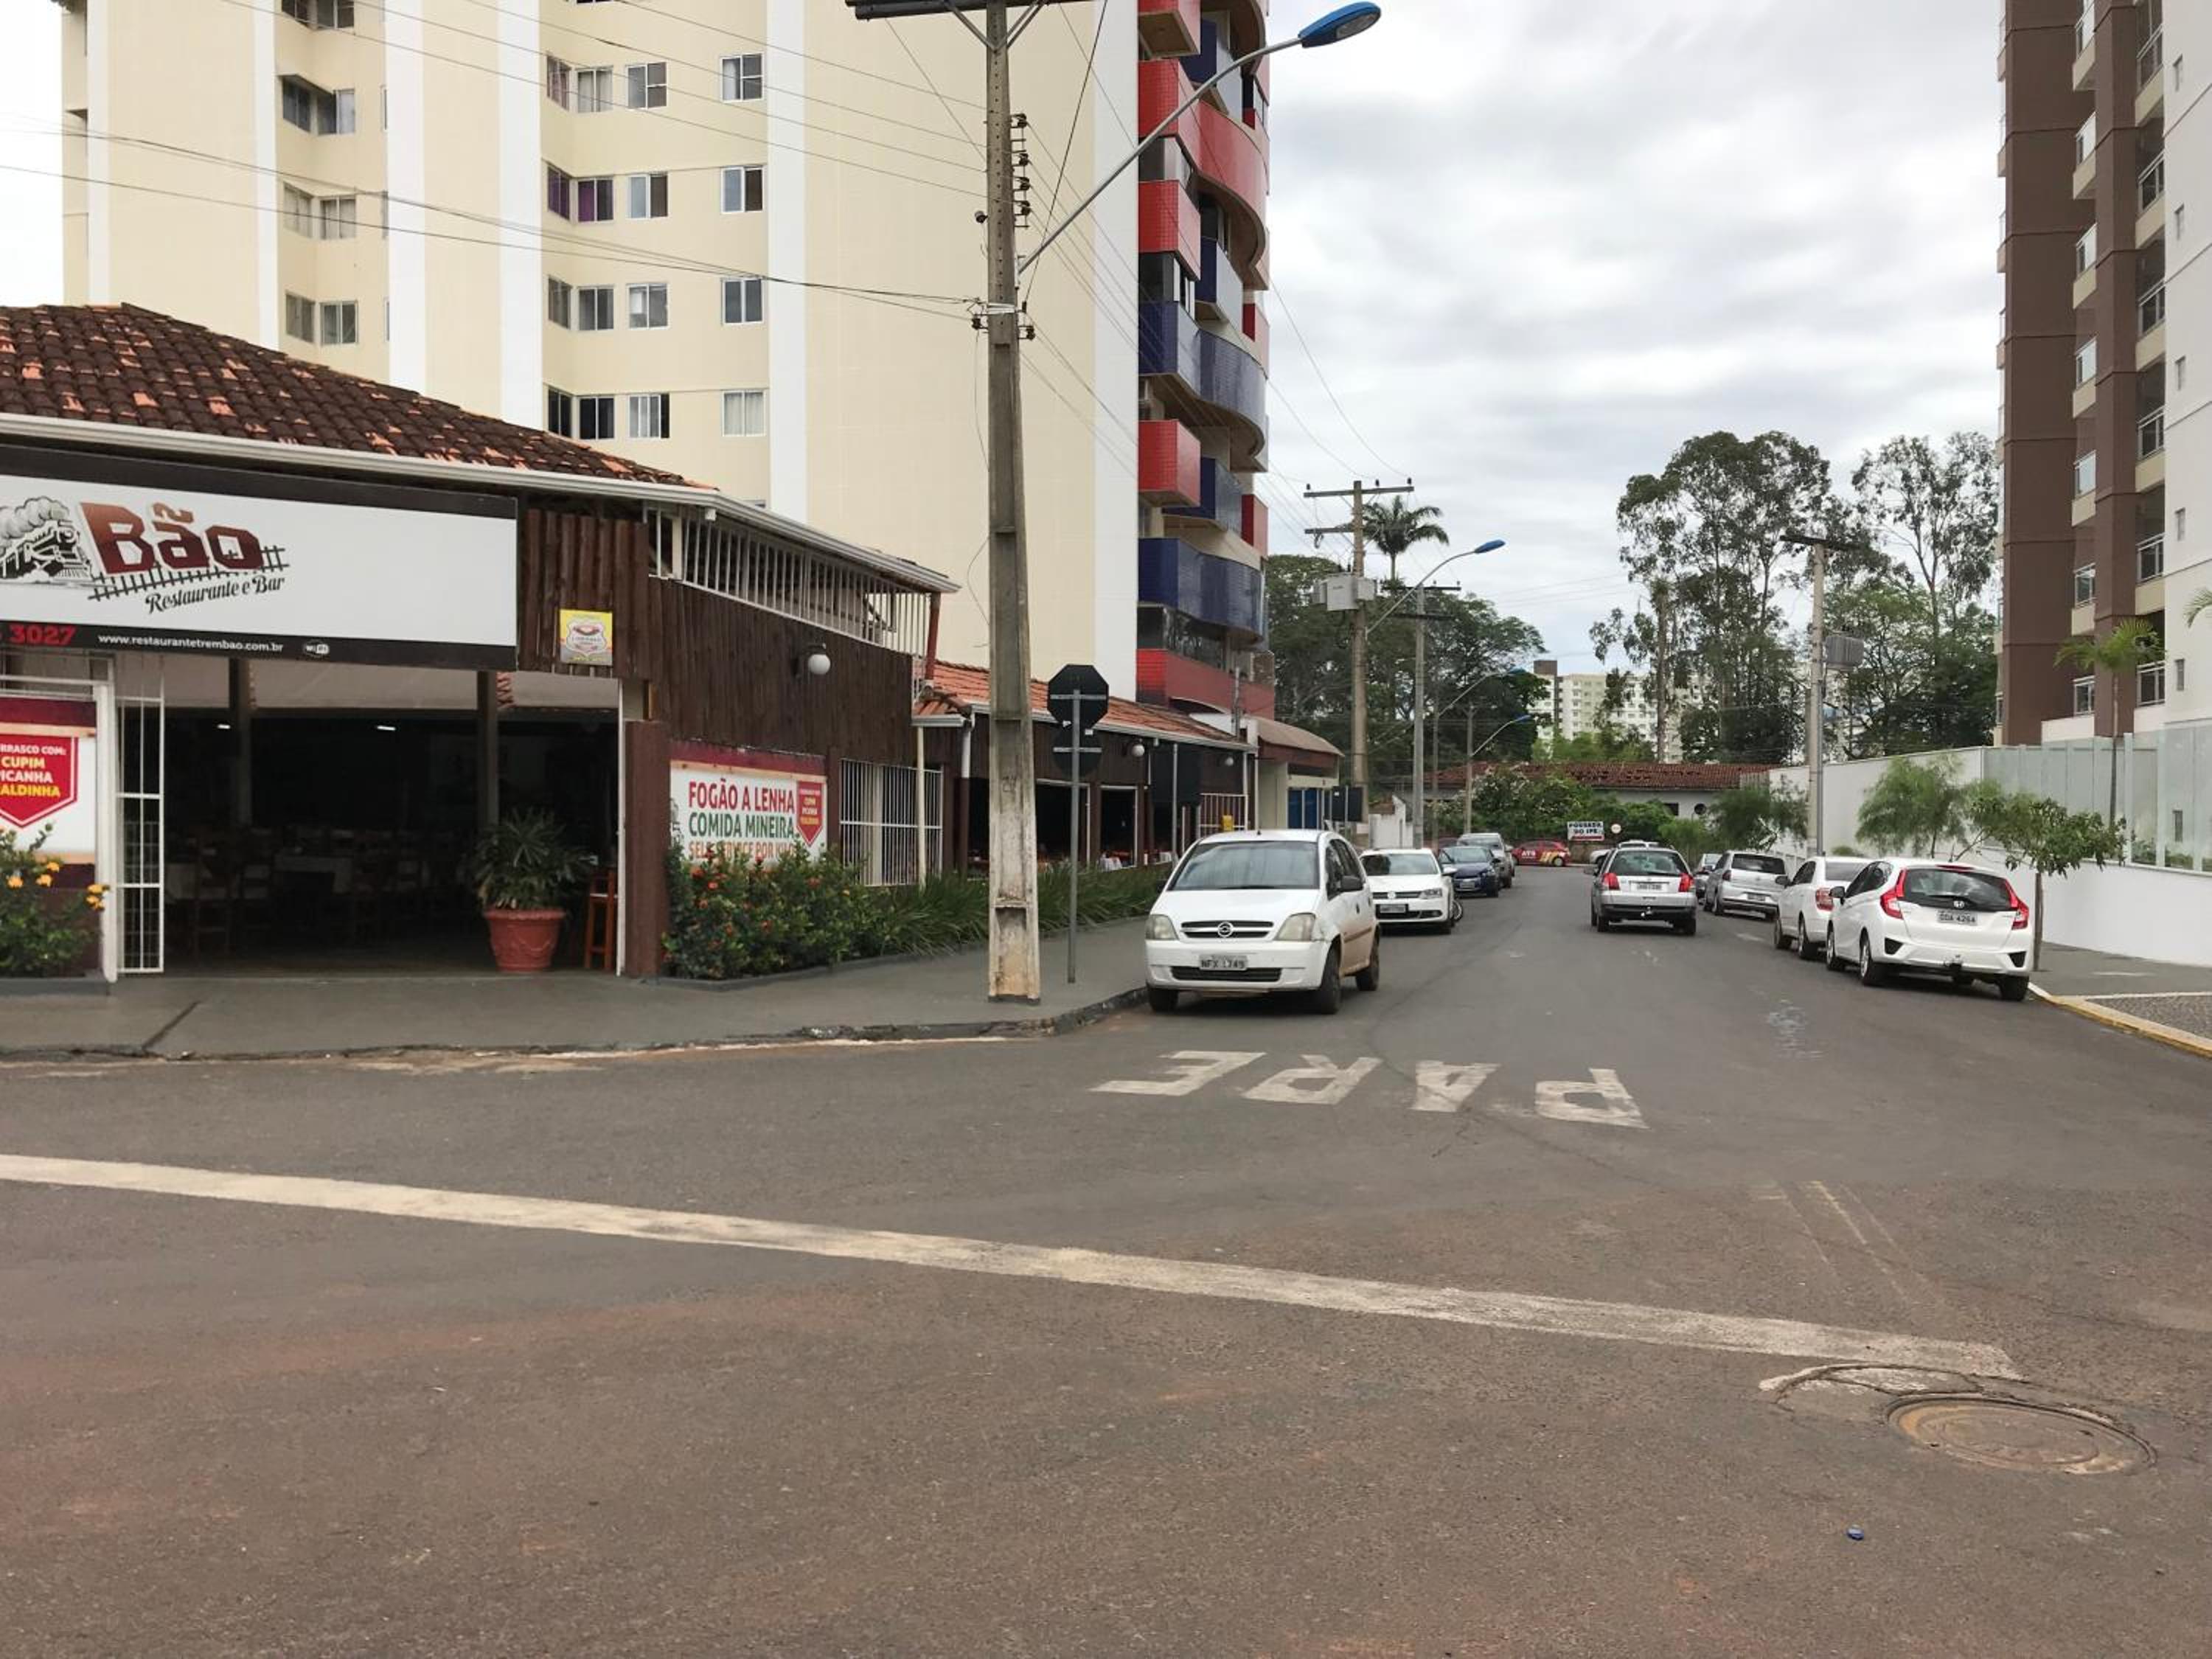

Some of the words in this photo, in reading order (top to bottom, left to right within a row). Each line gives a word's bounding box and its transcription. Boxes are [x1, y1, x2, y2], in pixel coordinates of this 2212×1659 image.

[80, 502, 264, 574] Bão
[145, 580, 240, 613] Restaurante
[242, 583, 248, 594] e
[251, 574, 285, 594] Bar
[10, 625, 77, 645] 3027
[98, 633, 284, 652] www.restaurantetrembao.com.br
[1, 756, 46, 768] CUPIM
[0, 770, 53, 783] ICANHA
[0, 784, 60, 798] ALDINHA
[689, 778, 738, 810] FOGÃO
[742, 785, 751, 810] A
[754, 787, 795, 813] LENHA
[689, 812, 742, 838] COMIDA
[745, 814, 794, 839] MINEIRA
[1087, 1050, 1650, 1129] PARE
